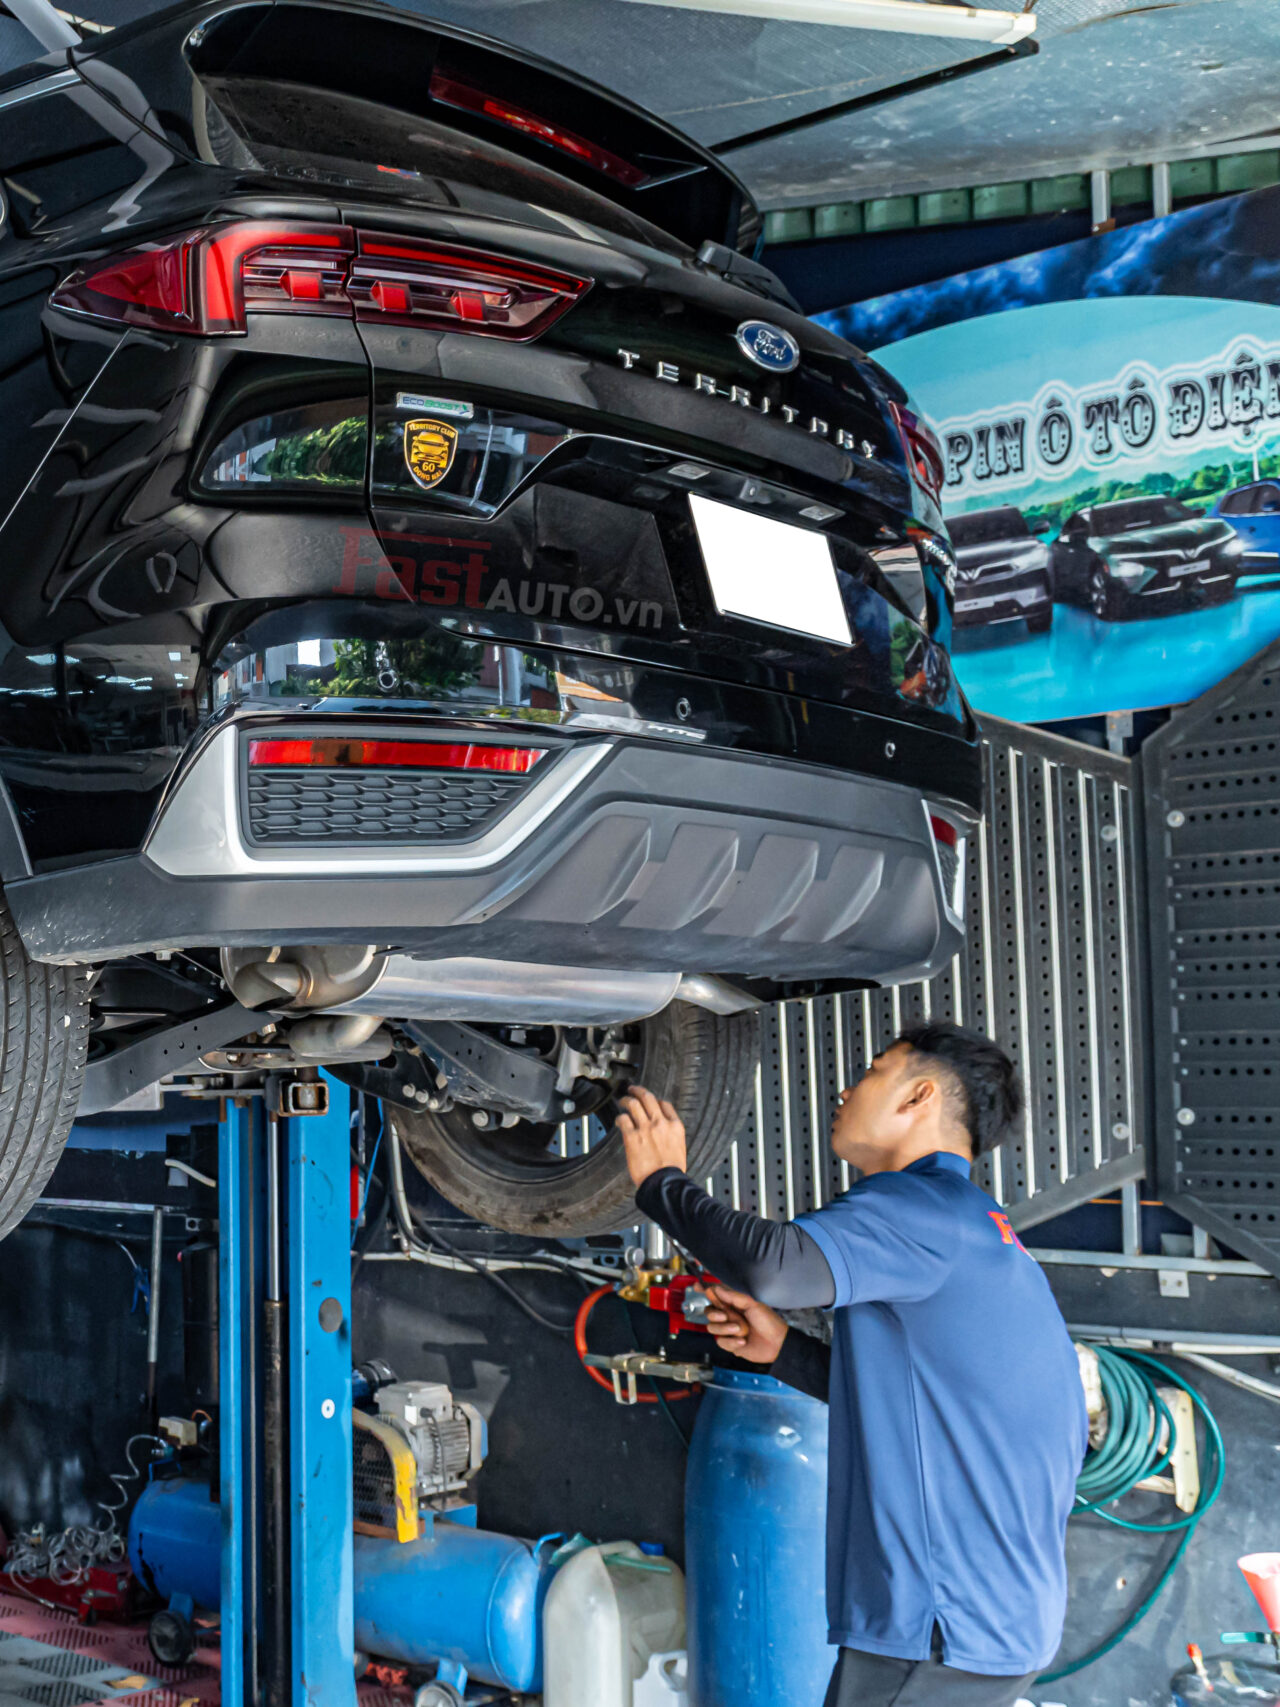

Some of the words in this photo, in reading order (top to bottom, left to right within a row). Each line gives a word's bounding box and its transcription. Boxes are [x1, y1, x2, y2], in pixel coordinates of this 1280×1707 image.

[618, 348, 877, 459] TERRITORY
[944, 416, 1026, 486] PIN
[1037, 396, 1072, 465] Ô
[1083, 377, 1157, 454] TÔ
[422, 462, 435, 472] 60
